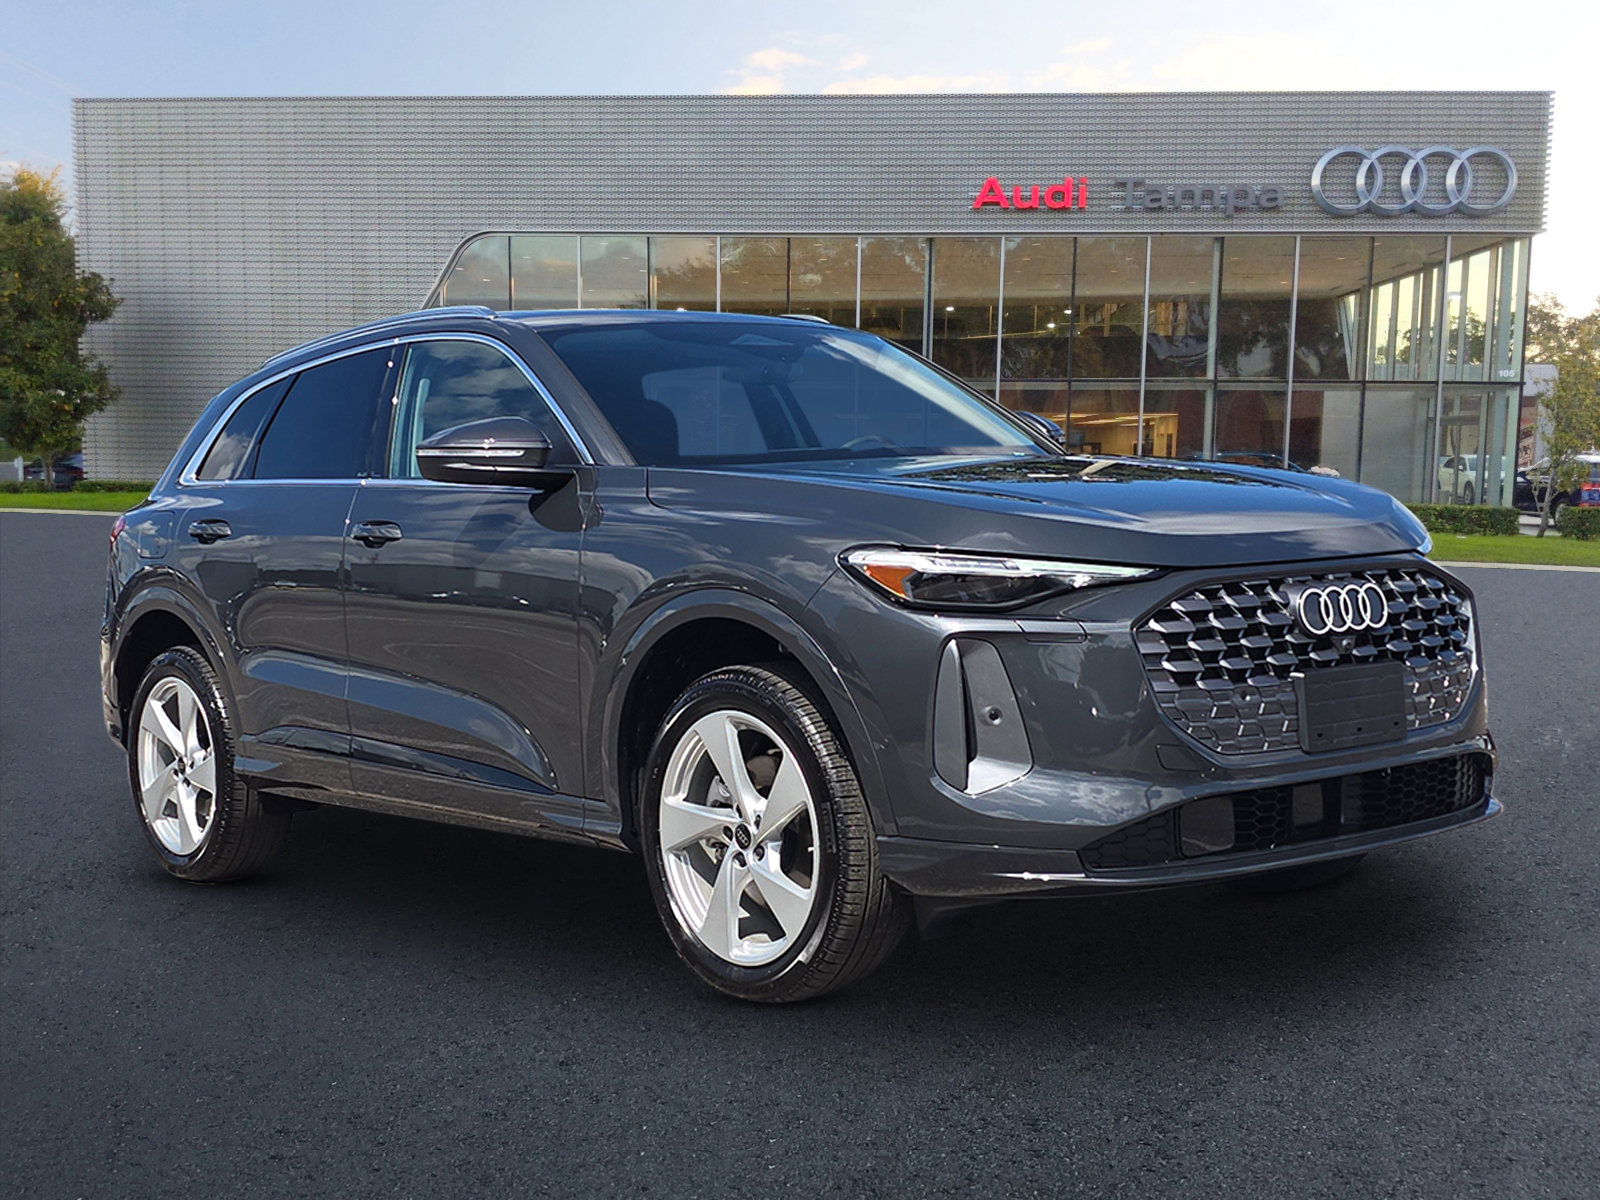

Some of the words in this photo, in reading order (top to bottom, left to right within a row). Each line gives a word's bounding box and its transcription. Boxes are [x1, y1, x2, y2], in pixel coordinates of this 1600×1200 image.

[972, 177, 1088, 210] Audi
[1113, 177, 1286, 218] Tampa
[1498, 369, 1515, 378] 105
